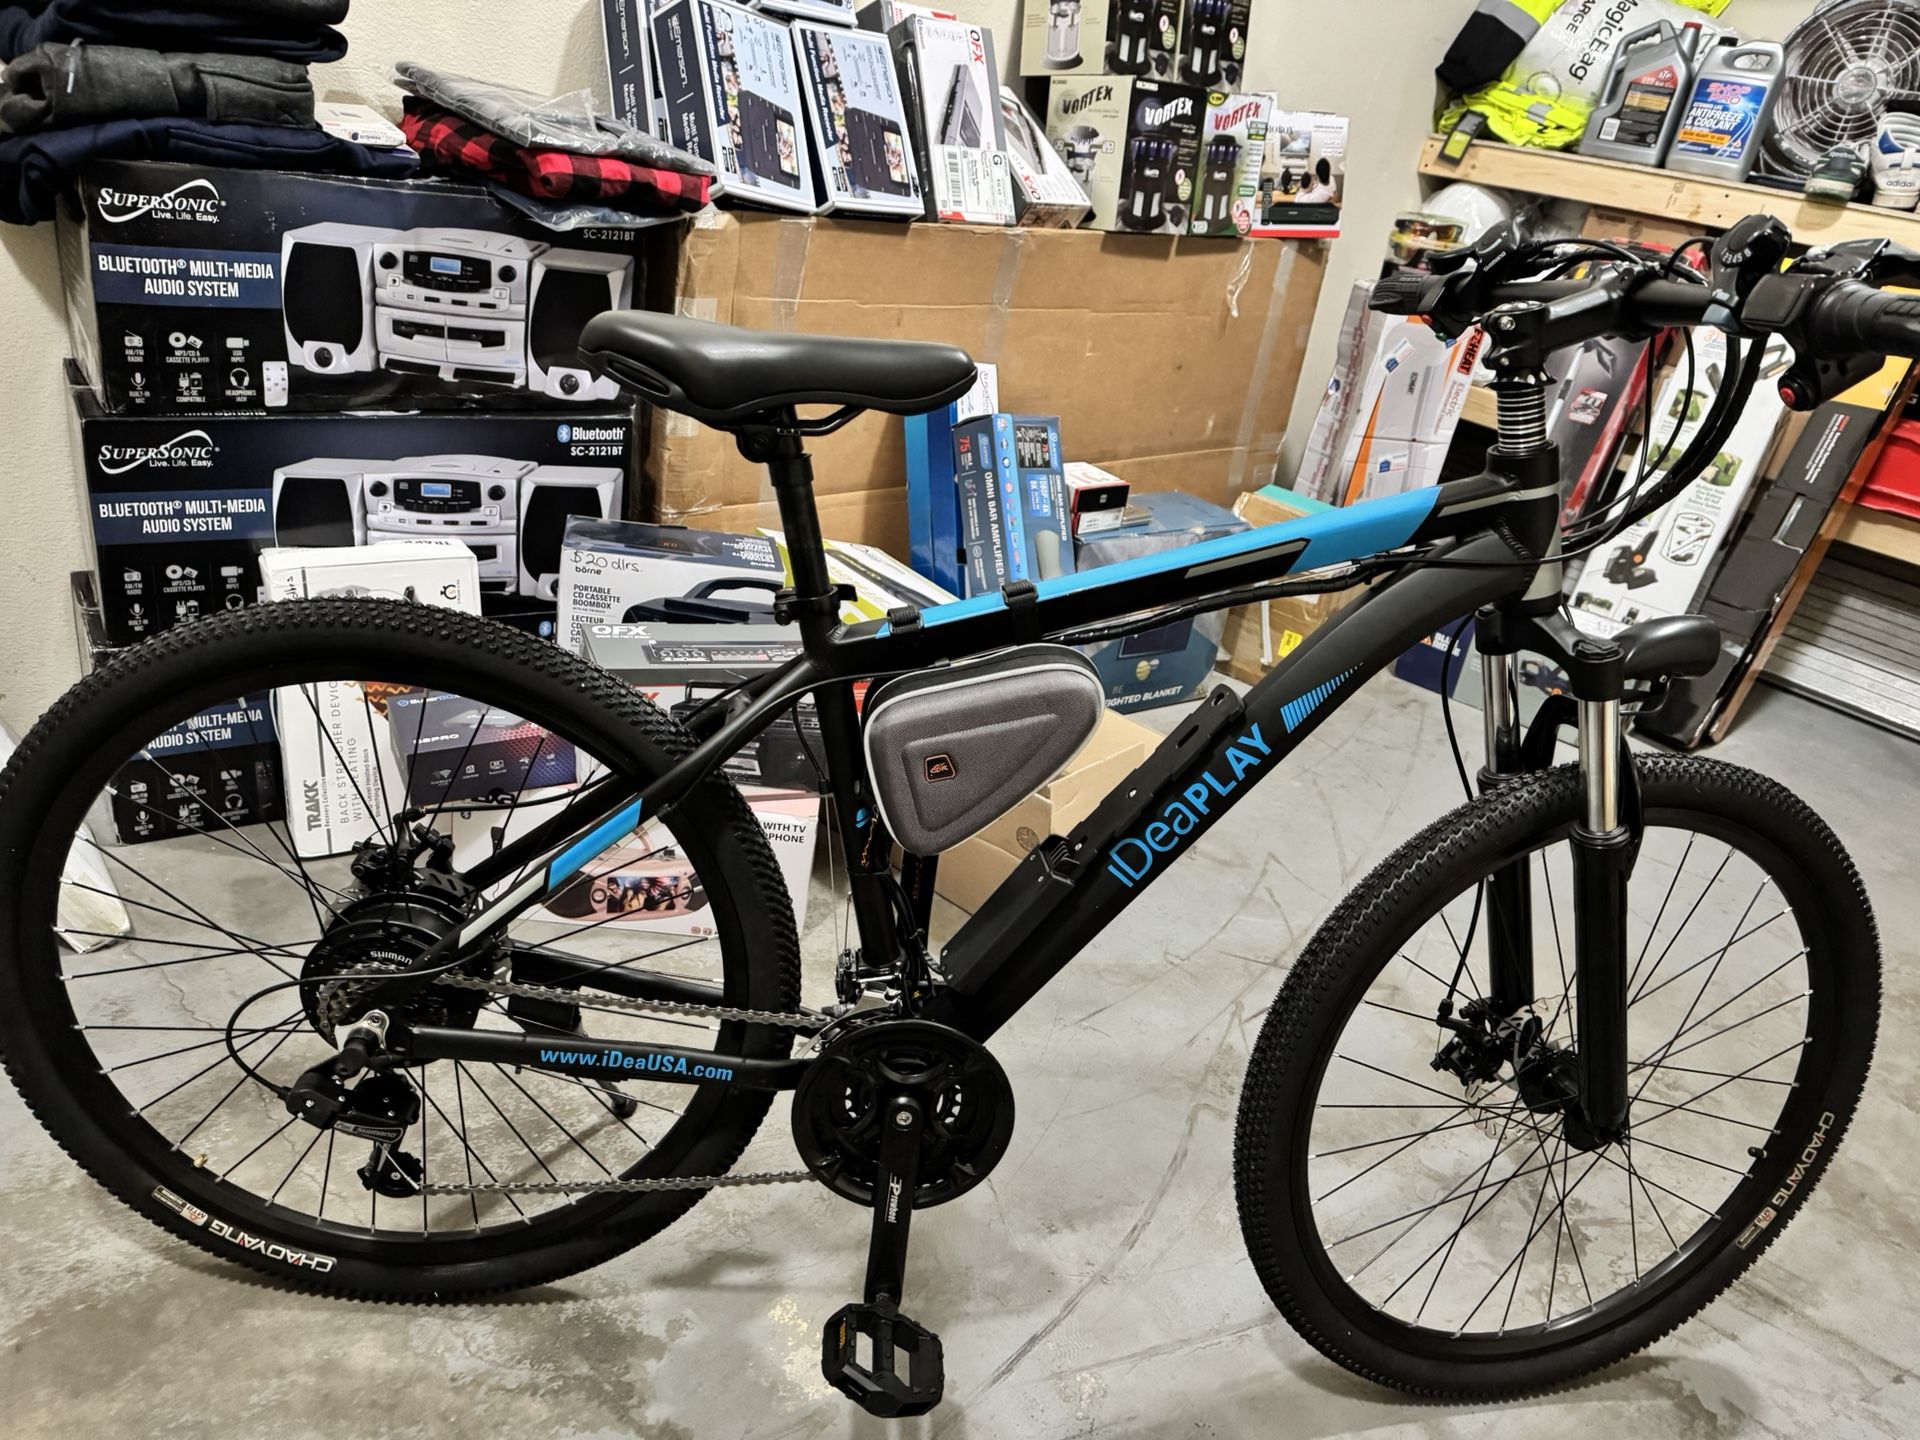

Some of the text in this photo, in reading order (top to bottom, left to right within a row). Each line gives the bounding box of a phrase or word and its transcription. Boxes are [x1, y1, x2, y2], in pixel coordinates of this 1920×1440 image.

[706, 25, 716, 60] Function
[715, 84, 726, 120] Recorder
[810, 50, 820, 83] Function
[816, 83, 825, 106] Media
[822, 107, 833, 142] Recorder
[1707, 82, 1751, 94] SHOP
[1062, 85, 1113, 115] VORTEX
[1708, 93, 1741, 104] PRO
[1144, 97, 1194, 126] VORTEX
[1214, 102, 1262, 132] VORTEX
[1689, 107, 1745, 123] ANTIFREEZE
[1695, 117, 1738, 131] COOLANT
[152, 210, 220, 223] Live. Life. Easy.
[583, 229, 635, 240] SC-2121BT
[98, 255, 274, 279] BLUETOOTH® MULTI-MEDIA
[144, 278, 239, 298] AUDIO SYSTEM
[572, 427, 623, 440] Bluetooth
[570, 446, 623, 456] SC-2121BT
[959, 437, 971, 452] 75
[149, 459, 214, 468] Live. Life. Easy.
[984, 471, 994, 498] OMNI
[99, 498, 266, 518] BLUETOOTH® MULTI-MEDIA
[987, 499, 998, 521] BAR
[142, 517, 233, 534] AUDIO SYSTEM
[989, 522, 1004, 576] AMPLIFIED
[574, 566, 602, 576] börne
[573, 584, 612, 595] PORTABLE
[573, 592, 621, 603] CD CASSETTE
[572, 599, 612, 610] BOOMBOX
[571, 614, 604, 624] LECTEUR
[591, 625, 648, 636] QFX
[1142, 686, 1183, 701] BLANKET
[148, 728, 232, 750] AUDIO SYSTEM
[302, 779, 322, 831] TRAKK
[339, 797, 350, 825] BACK
[763, 821, 806, 832] WITH TV
[540, 1049, 733, 1082] www.iDeaUSA.com
[1772, 1111, 1836, 1207] CHAOYANG
[208, 1219, 333, 1273] CHAOYANG
